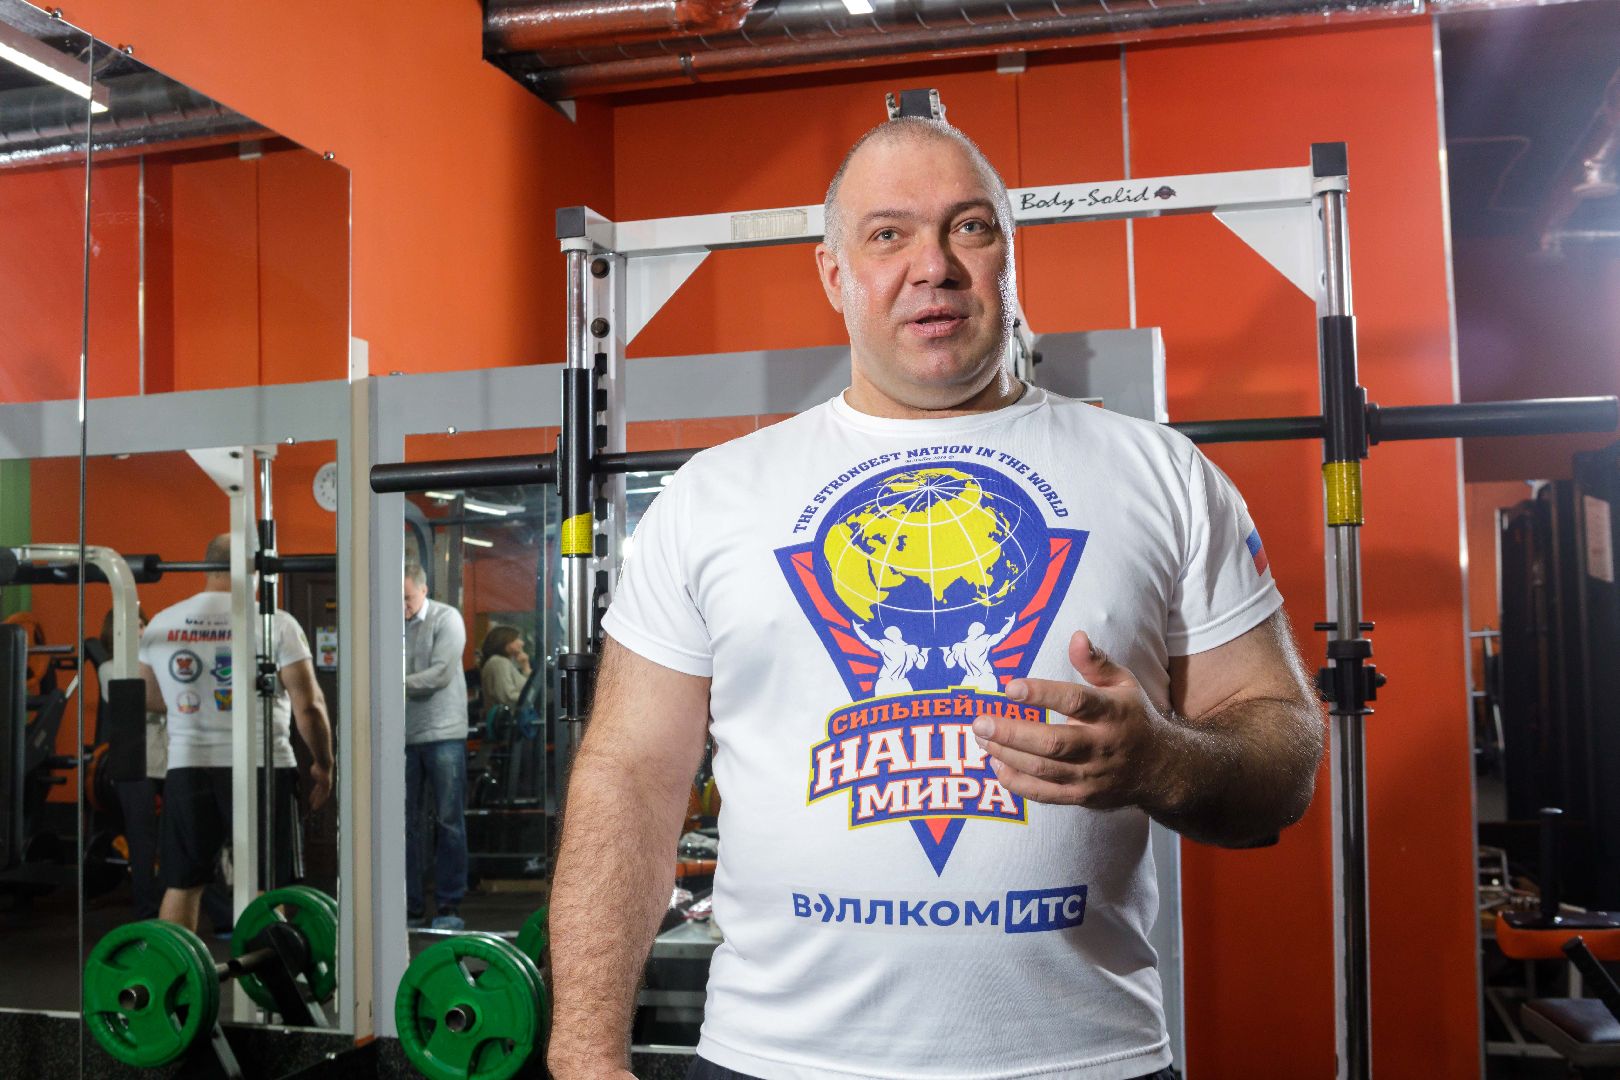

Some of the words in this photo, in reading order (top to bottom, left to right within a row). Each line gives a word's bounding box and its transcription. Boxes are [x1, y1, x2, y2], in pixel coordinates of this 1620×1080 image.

[1020, 186, 1149, 213] Body-Solid
[792, 505, 819, 534] THE
[813, 451, 901, 504] STRONGEST
[906, 444, 973, 458] NATION
[976, 446, 996, 458] IN
[998, 452, 1030, 475] THE
[1027, 471, 1069, 518] WORLD
[832, 694, 1040, 735] СИЛЬНЕЙШАЯ
[813, 723, 993, 794] НАЦ
[856, 776, 1018, 820] МИРА
[1011, 894, 1082, 926] ИТС
